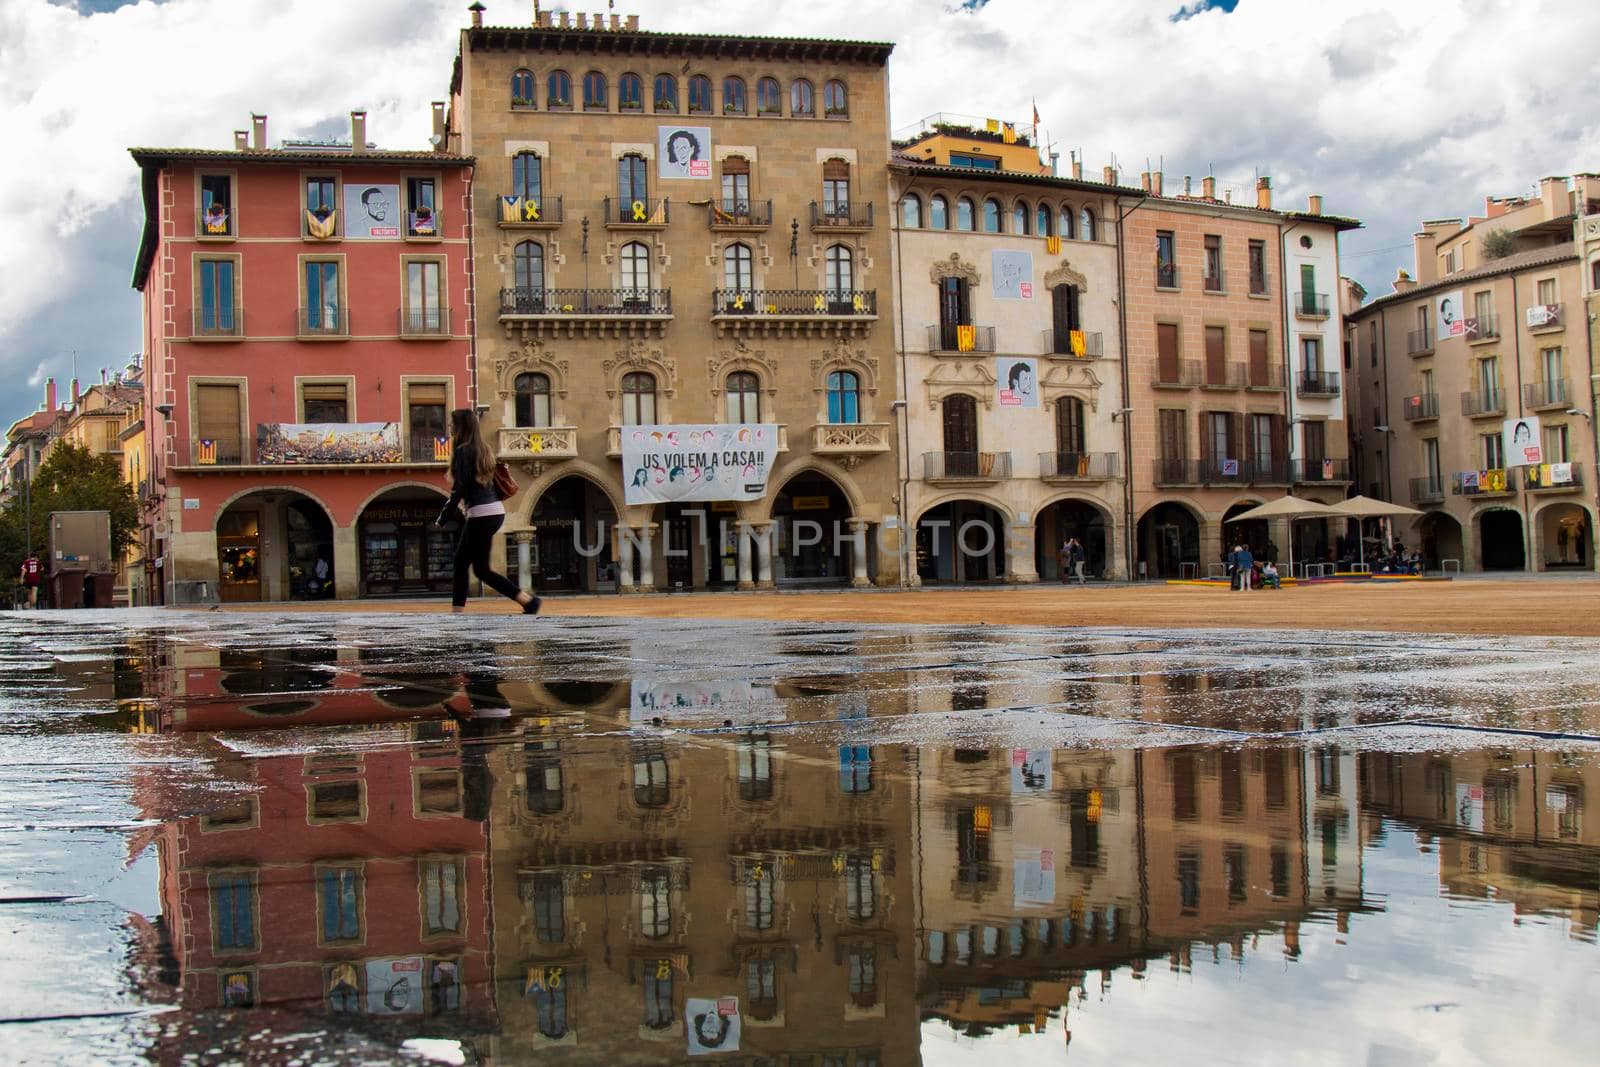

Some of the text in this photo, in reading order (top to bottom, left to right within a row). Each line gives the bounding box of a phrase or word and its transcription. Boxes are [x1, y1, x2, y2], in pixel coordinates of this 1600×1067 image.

[643, 451, 764, 469] US VOLEM A CASA!!
